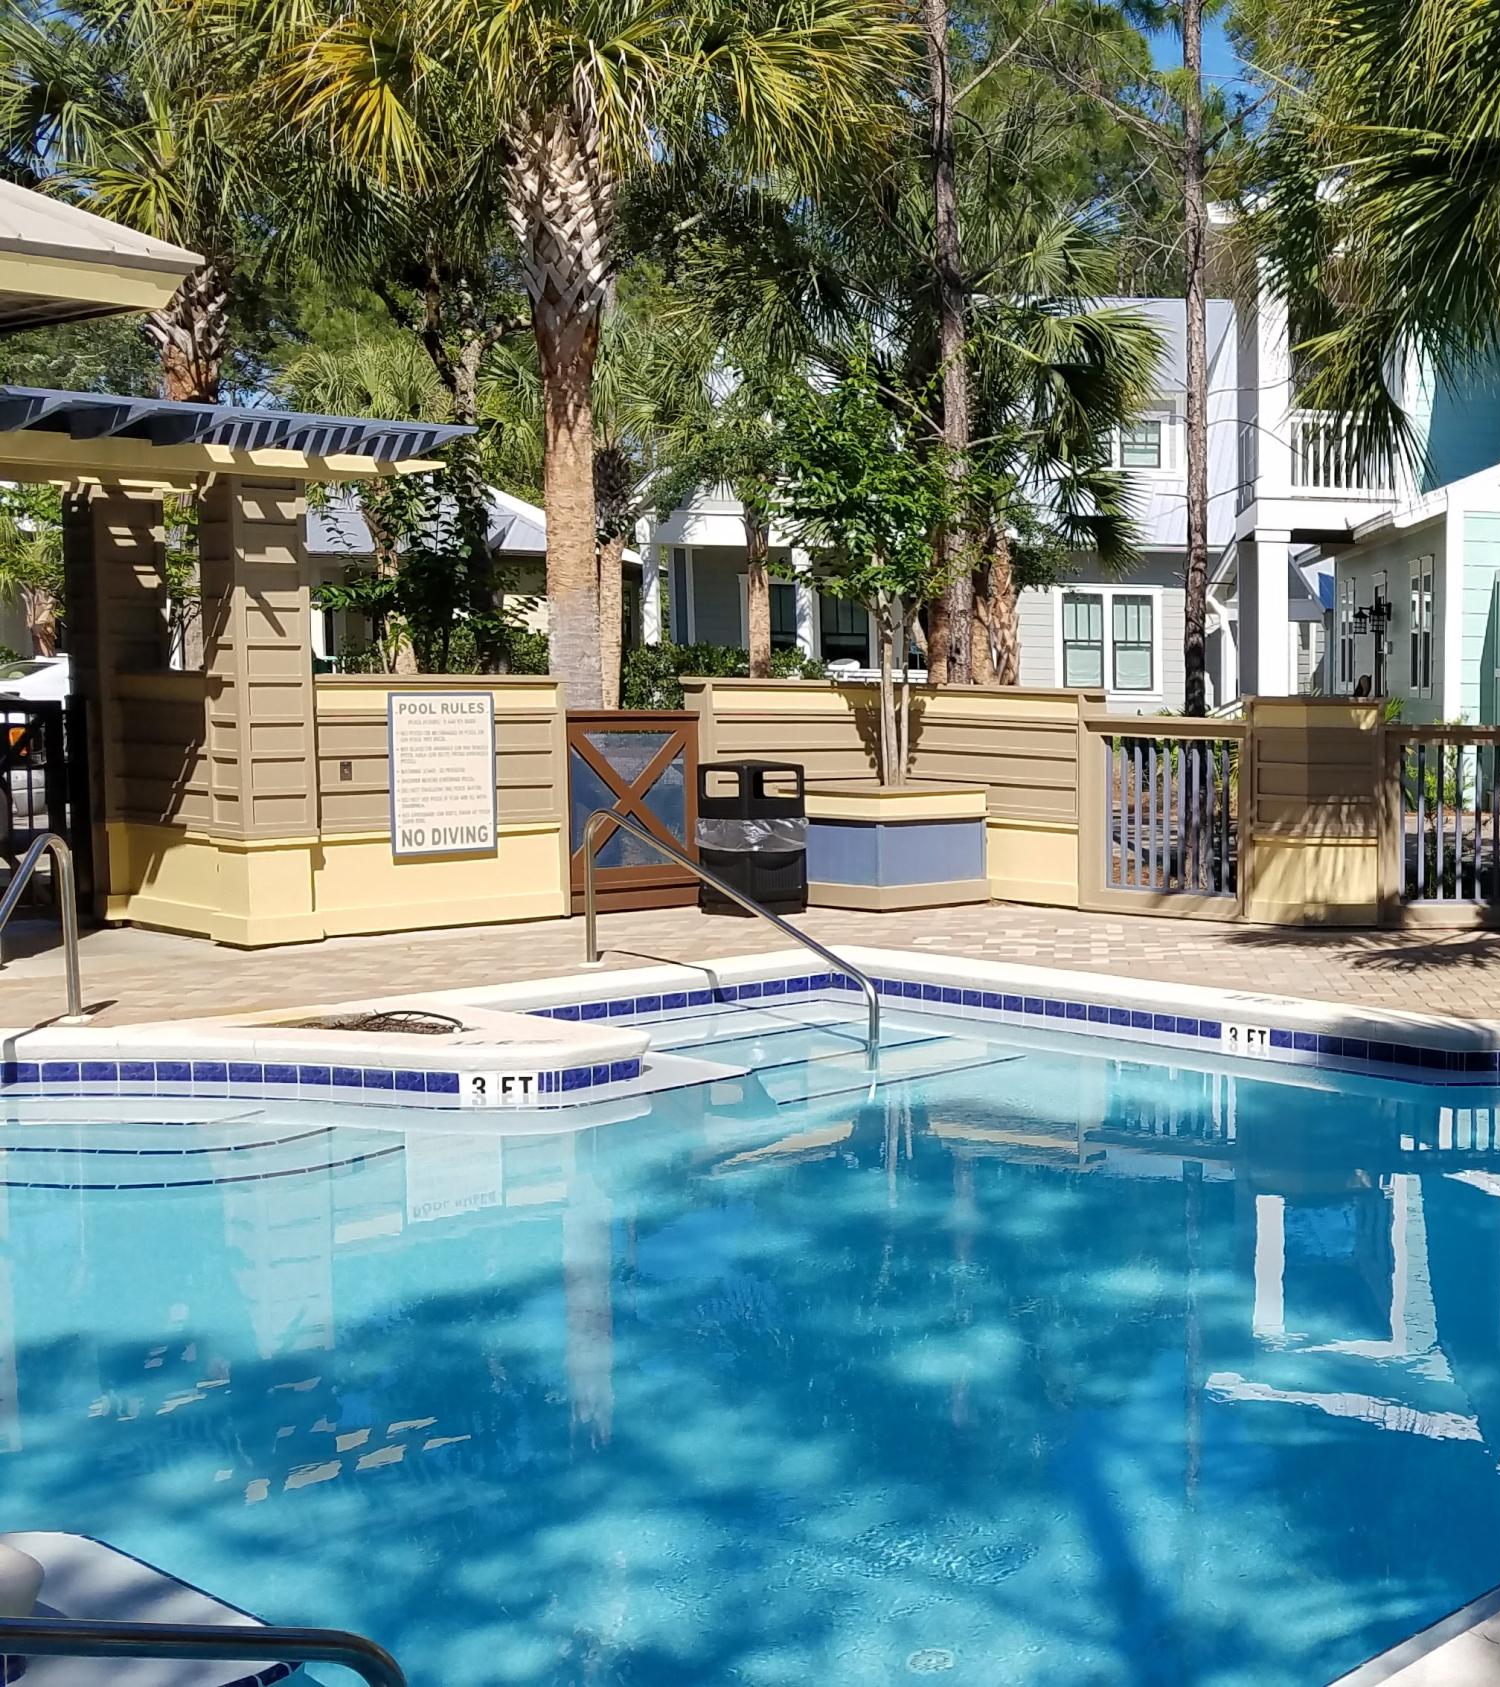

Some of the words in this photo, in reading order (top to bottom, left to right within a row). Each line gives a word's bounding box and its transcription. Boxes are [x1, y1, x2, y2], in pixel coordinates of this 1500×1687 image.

[399, 703, 437, 715] POOL
[441, 702, 485, 715] RULES
[402, 829, 425, 847] NO
[431, 825, 488, 846] DIVING
[1229, 1027, 1238, 1042] 3
[1247, 1028, 1267, 1045] FT
[472, 1077, 486, 1094] 3
[502, 1076, 533, 1094] FT
